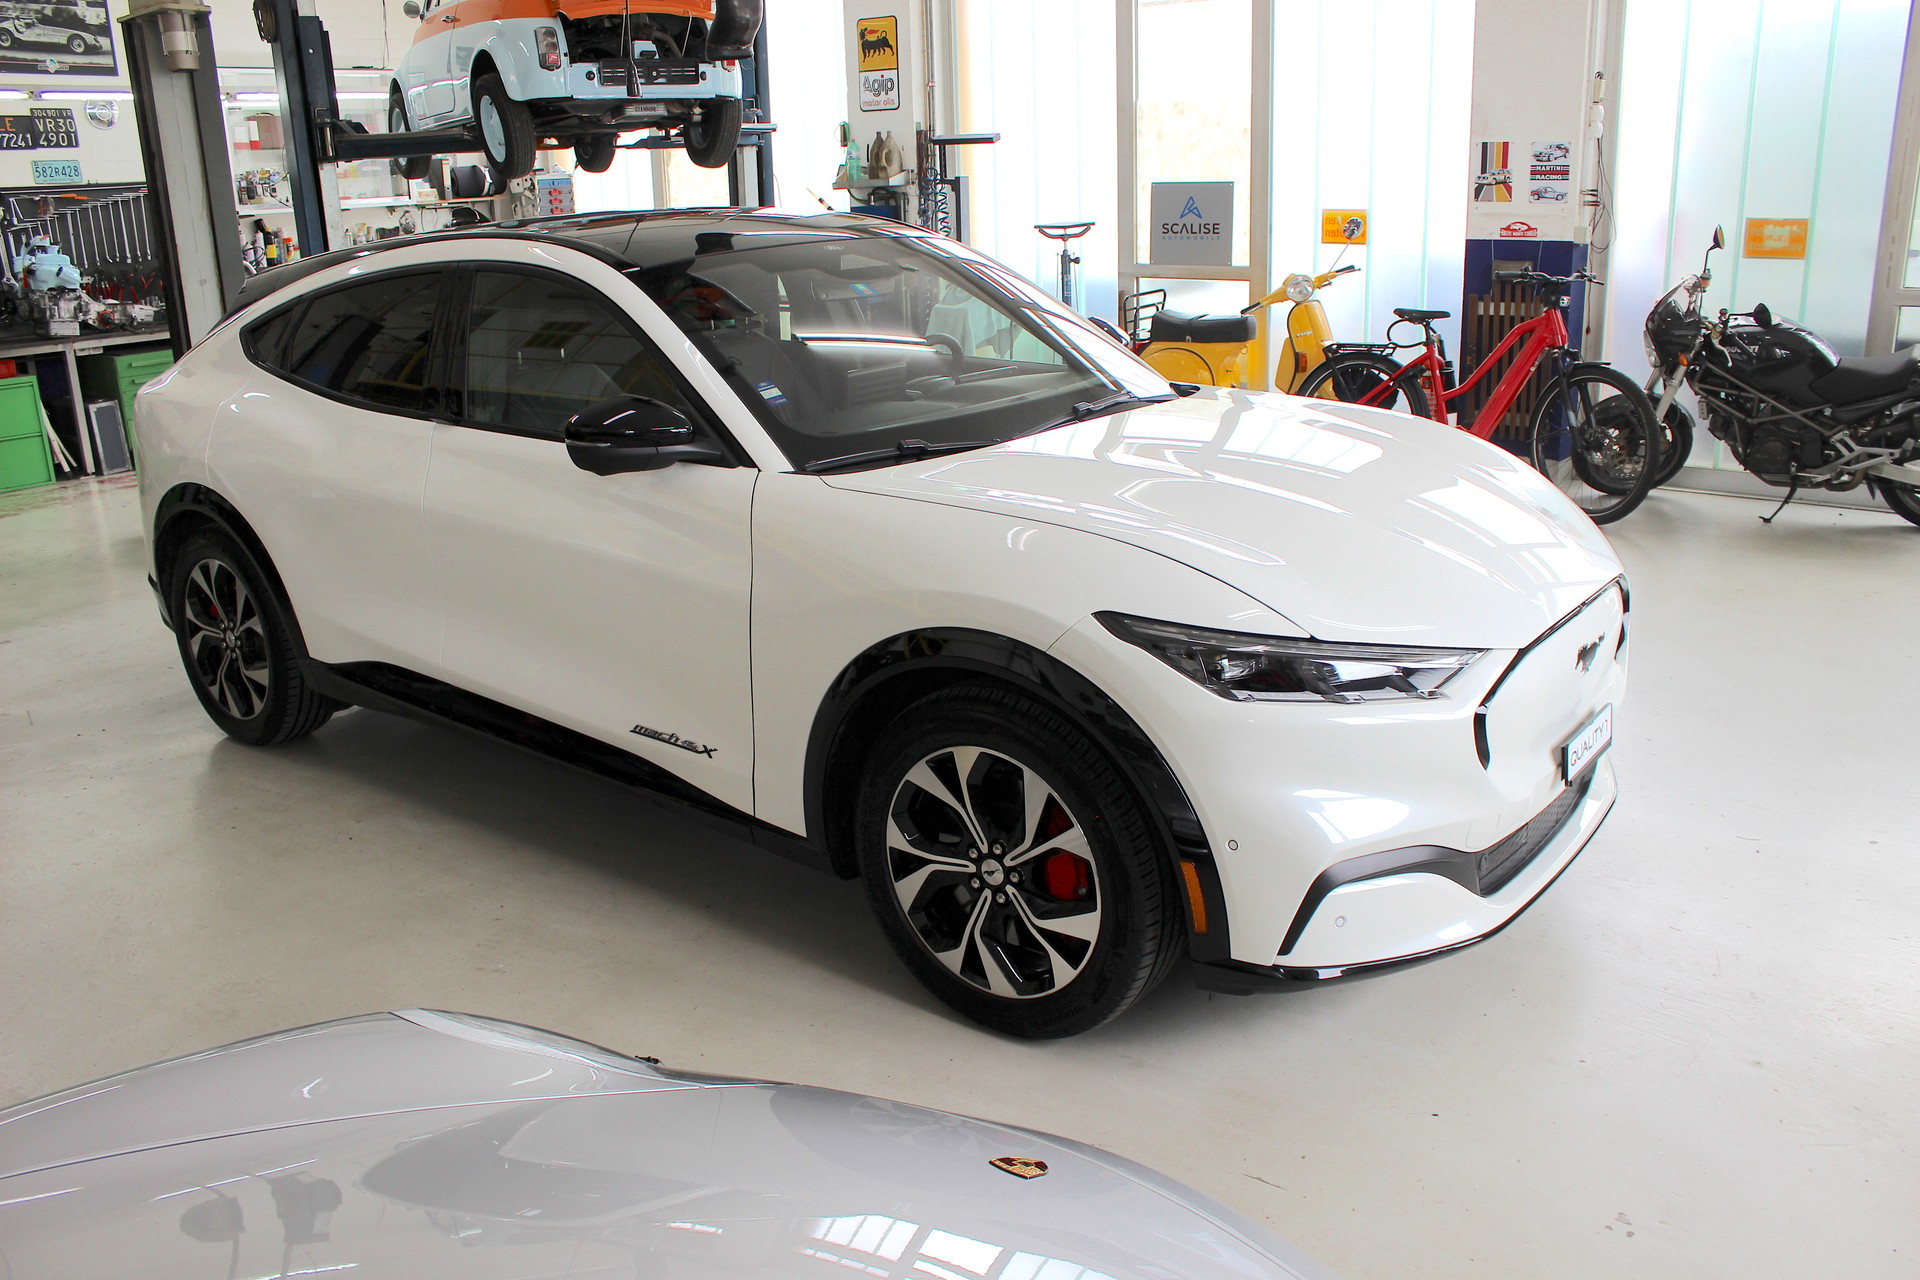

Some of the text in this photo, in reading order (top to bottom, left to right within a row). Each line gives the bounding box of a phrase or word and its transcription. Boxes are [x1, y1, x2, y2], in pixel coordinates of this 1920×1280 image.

[863, 74, 895, 98] Agip
[862, 97, 896, 108] motor oils
[32, 109, 60, 117] 304901
[35, 118, 76, 133] VR30
[39, 132, 76, 147] 4901
[35, 165, 80, 179] 582R428
[1161, 223, 1220, 235] SCALISE
[1570, 721, 1604, 767] QUALITY
